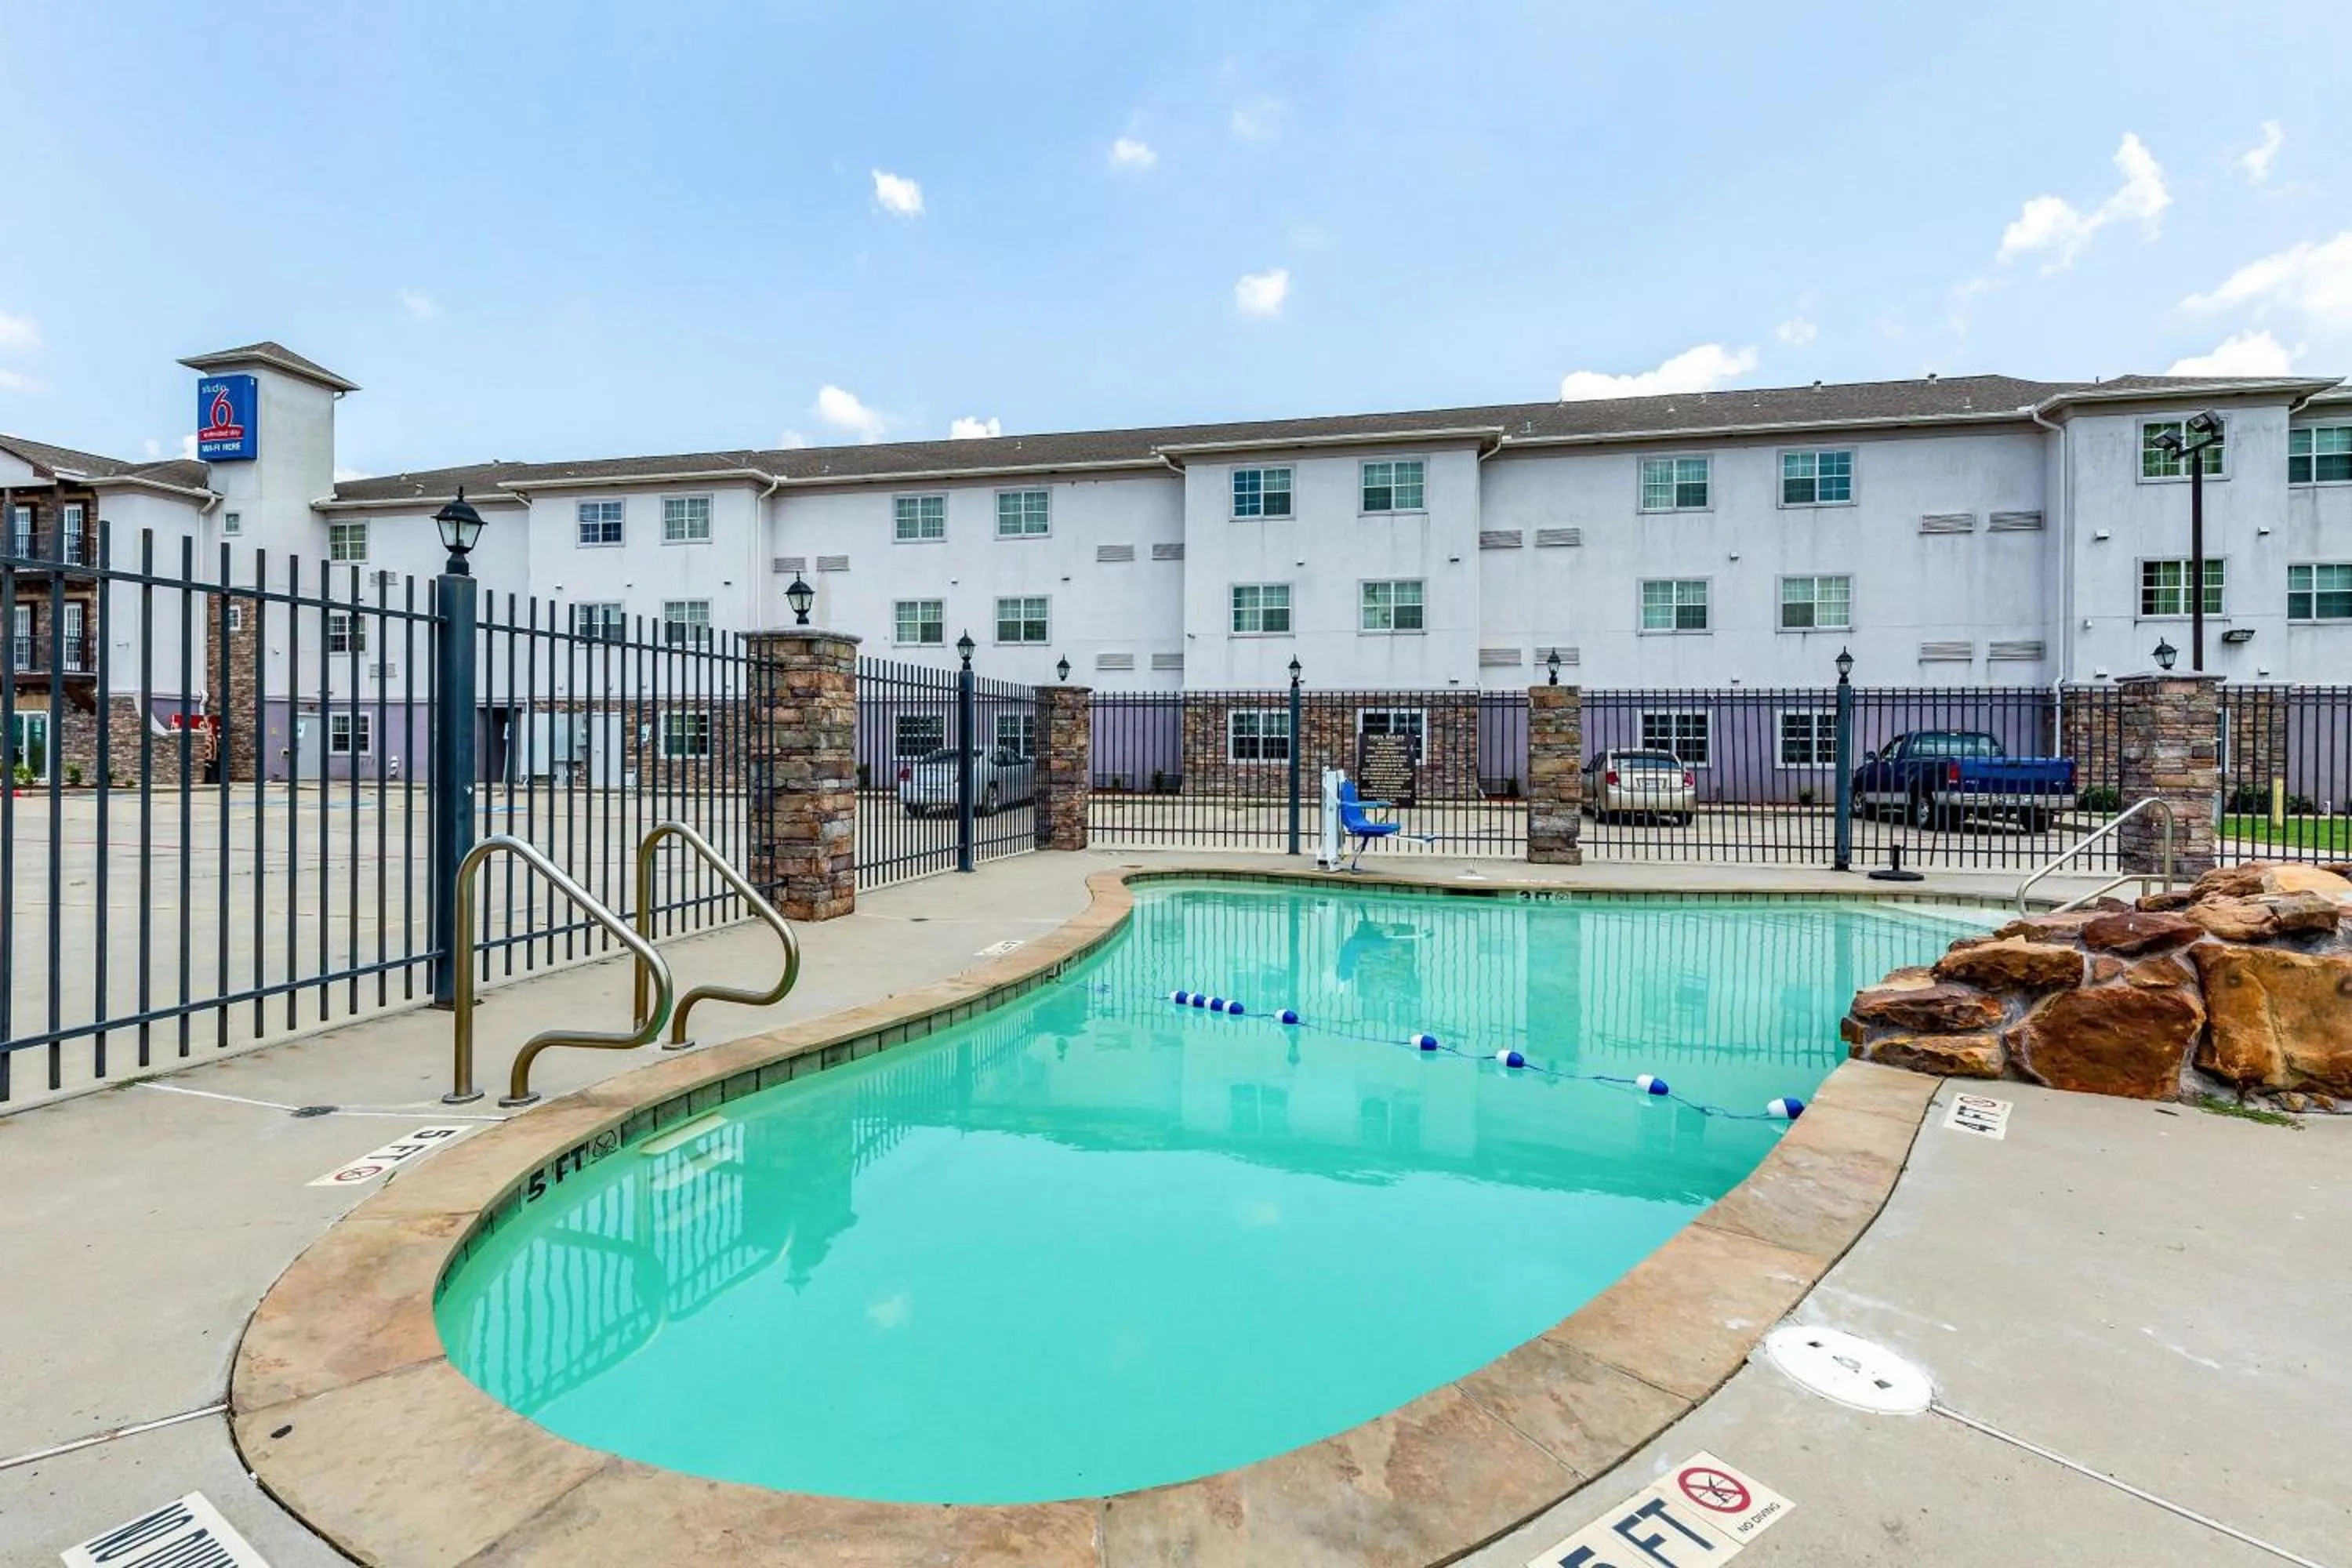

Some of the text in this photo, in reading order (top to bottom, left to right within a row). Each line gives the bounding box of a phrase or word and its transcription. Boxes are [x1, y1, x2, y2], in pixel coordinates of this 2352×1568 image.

[209, 389, 234, 427] 6
[201, 441, 241, 452] WI-FI HERE
[1955, 1105, 2001, 1133] 4 FT
[367, 1130, 456, 1161] 5 FT
[526, 1143, 586, 1203] 5 FT
[85, 1502, 195, 1563] NO
[1613, 1497, 1715, 1568] FT
[1737, 1501, 1781, 1533] NO DIVING
